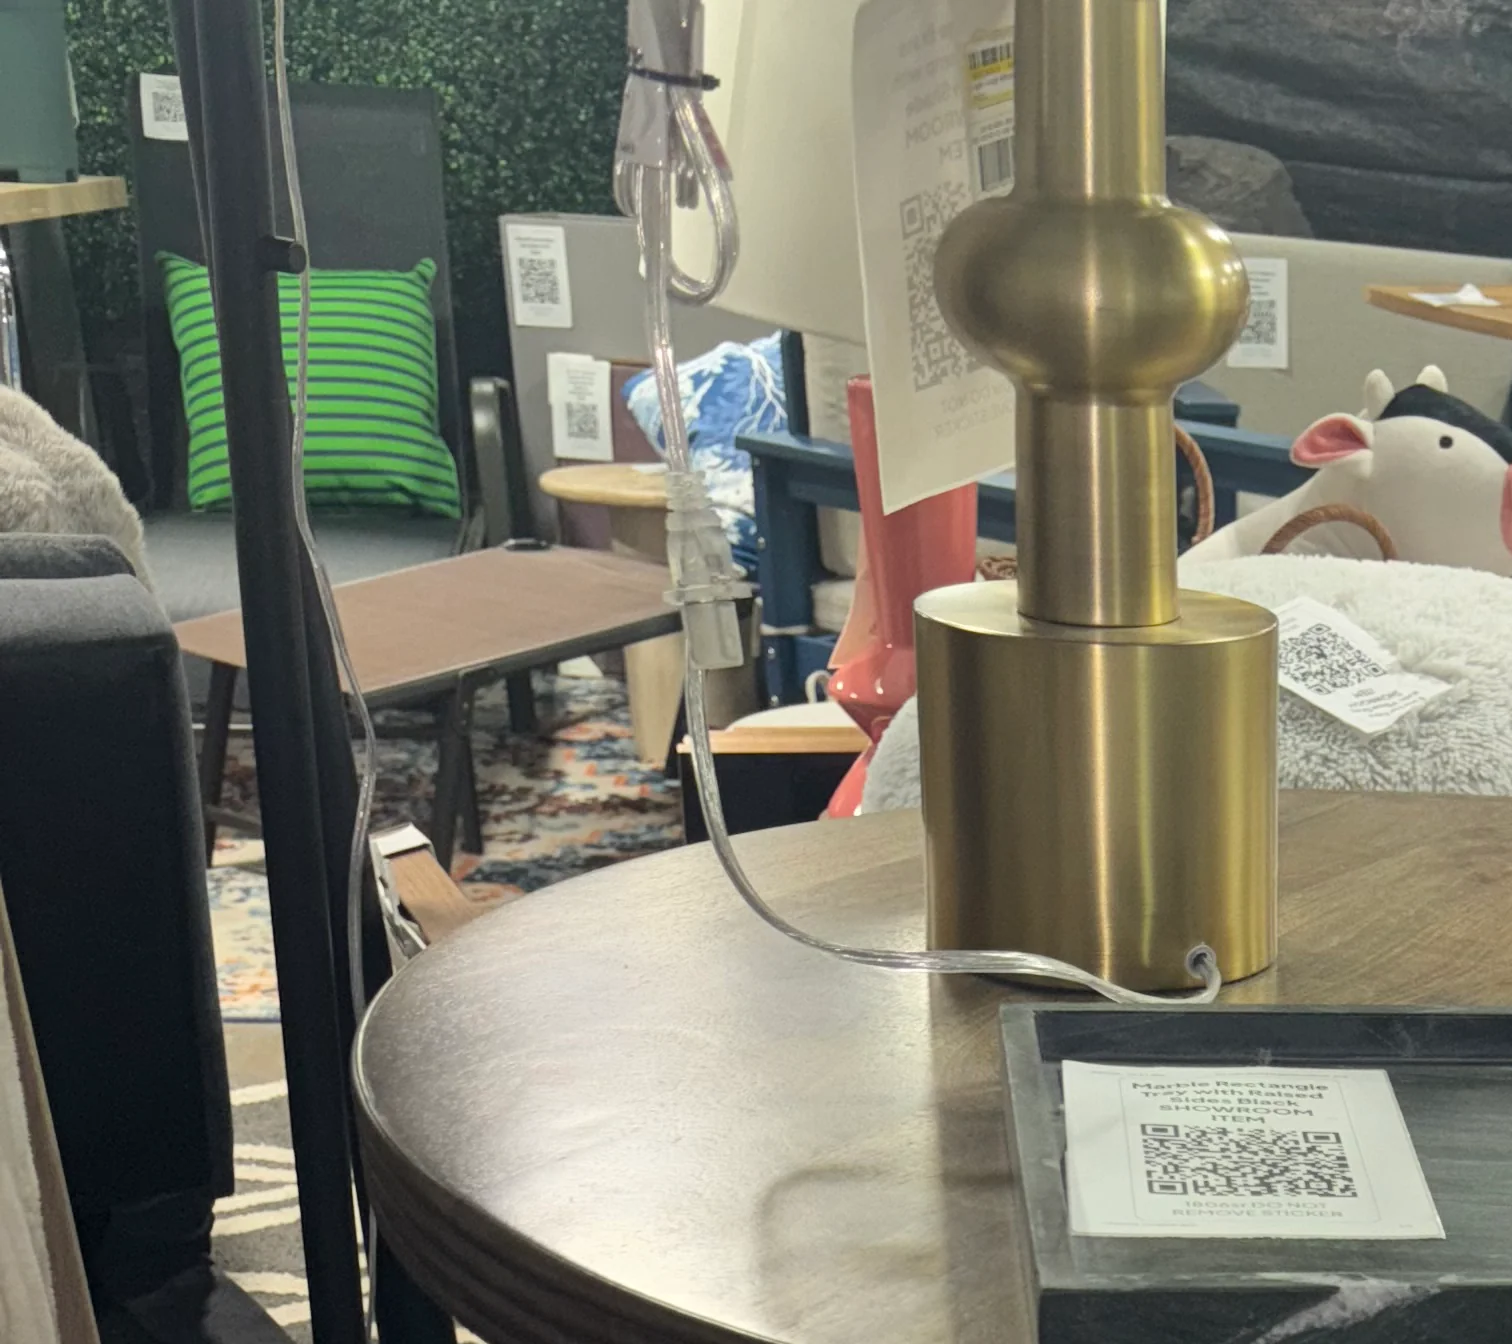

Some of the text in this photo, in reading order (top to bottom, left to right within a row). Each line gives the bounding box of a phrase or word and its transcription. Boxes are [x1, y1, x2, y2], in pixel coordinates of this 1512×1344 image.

[1132, 1081, 1329, 1091] Marble Rectangle
[1141, 1089, 1324, 1099] Tray with Raised
[1169, 1097, 1300, 1106] Sides Black
[1159, 1104, 1314, 1116] SHOWROOM
[1211, 1115, 1266, 1124] ITEM
[1251, 1201, 1282, 1209] DO
[1172, 1208, 1343, 1217] REMOVE STICKER
